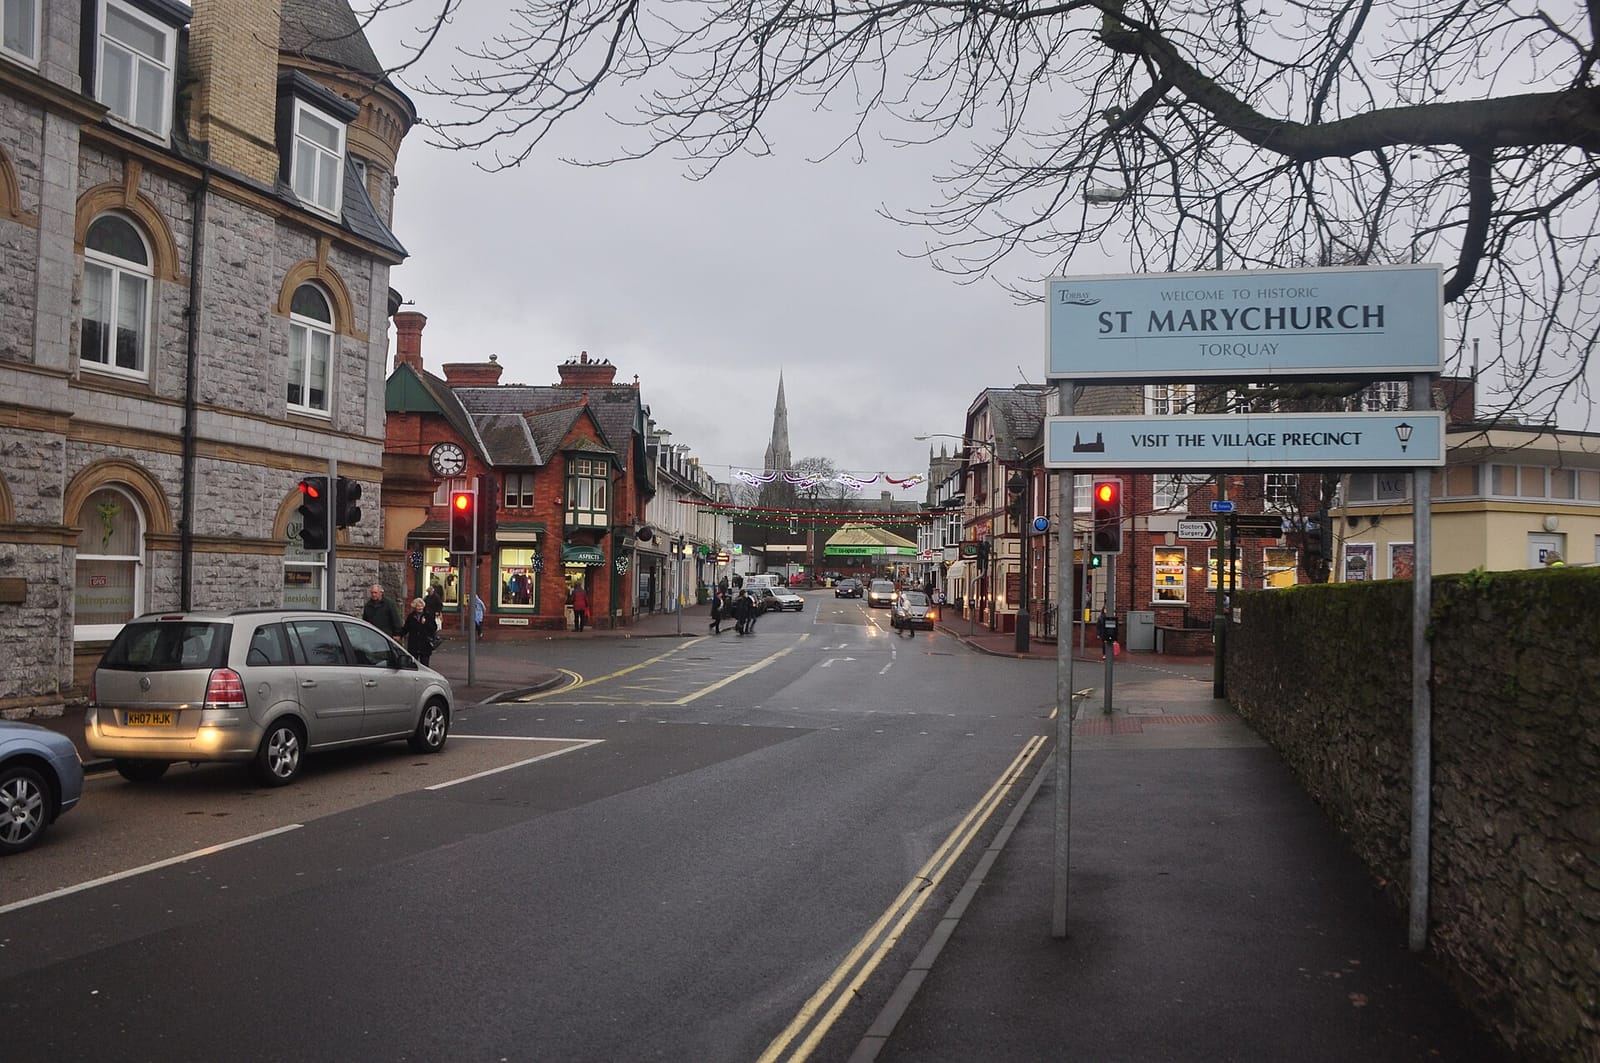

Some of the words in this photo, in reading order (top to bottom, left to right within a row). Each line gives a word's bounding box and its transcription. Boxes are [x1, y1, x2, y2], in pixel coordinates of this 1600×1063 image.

[1160, 290, 1225, 302] WELCOME
[1231, 289, 1251, 300] TO
[1257, 287, 1319, 299] HISTORIC
[1098, 310, 1133, 334] ST
[1147, 304, 1385, 333] MARYCHURCH
[1199, 342, 1280, 358] TORQUAY
[1131, 434, 1170, 447] VISIT
[1175, 433, 1206, 447] THE
[1212, 432, 1276, 447] VILLAGE
[1282, 431, 1363, 446] PRECINCT
[129, 713, 151, 724] KH07
[152, 713, 171, 724] HJK
